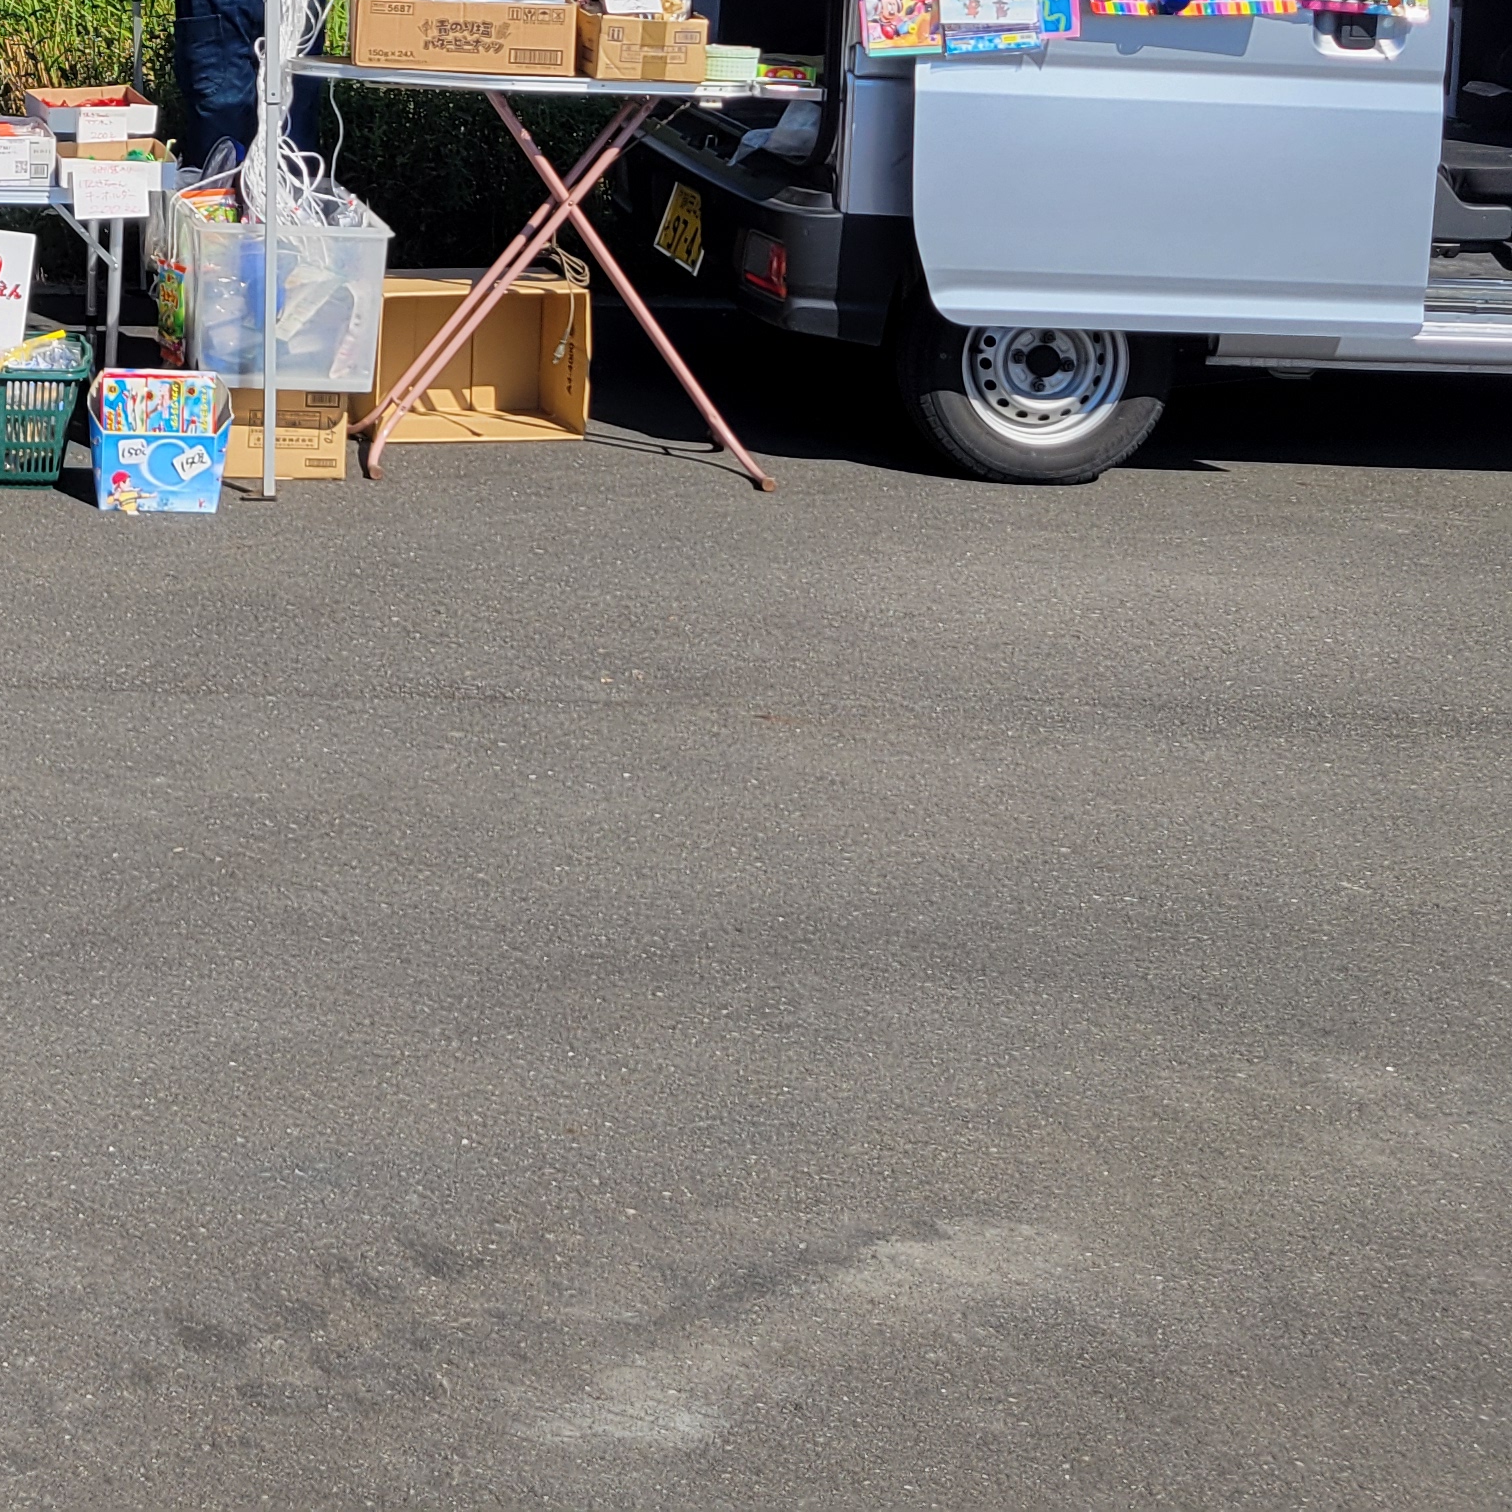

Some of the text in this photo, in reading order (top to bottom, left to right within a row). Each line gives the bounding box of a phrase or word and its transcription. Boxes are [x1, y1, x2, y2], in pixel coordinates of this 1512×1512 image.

[388, 4, 412, 13] 5687
[436, 19, 494, 38] 青のり塩
